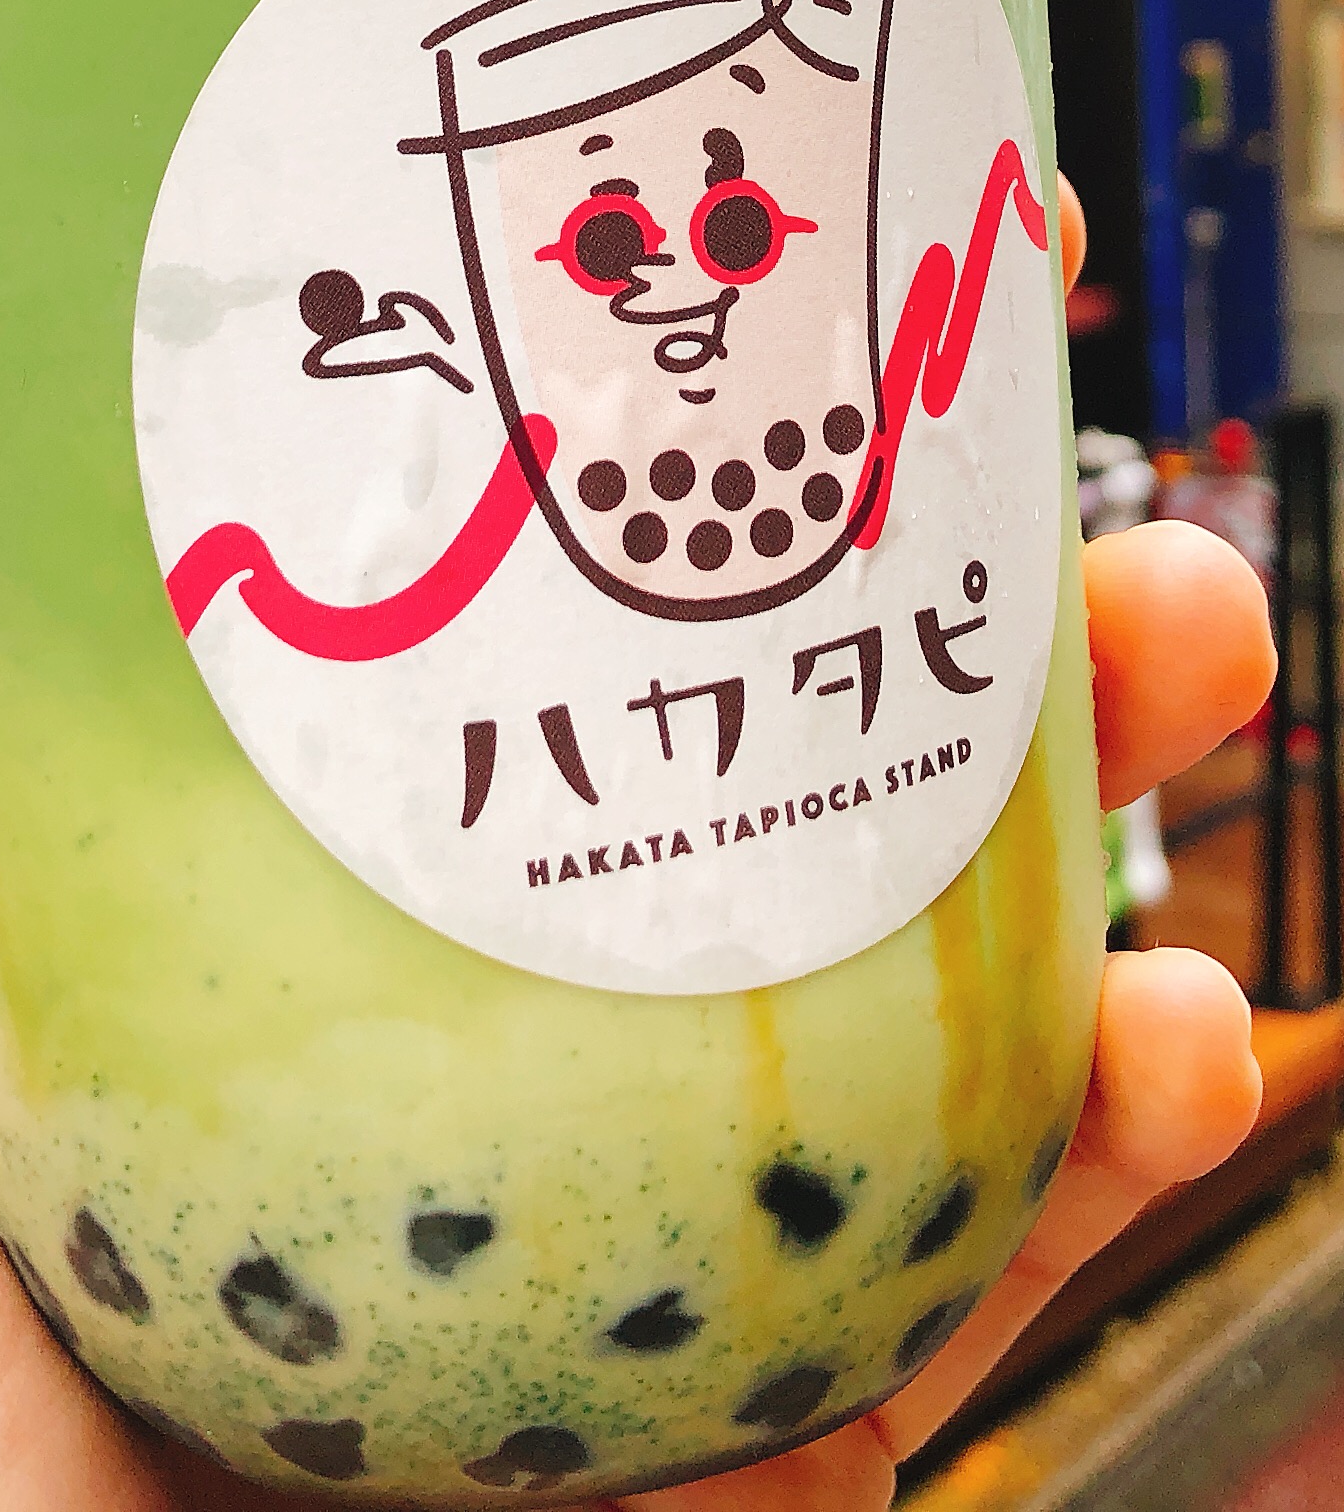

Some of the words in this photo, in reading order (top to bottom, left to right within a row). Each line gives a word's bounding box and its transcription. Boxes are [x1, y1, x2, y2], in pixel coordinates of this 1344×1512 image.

[460, 560, 993, 830] ハカタピ
[526, 833, 694, 889] HAKATA
[709, 777, 872, 848] TAPIOCA
[885, 736, 974, 795] STAND
